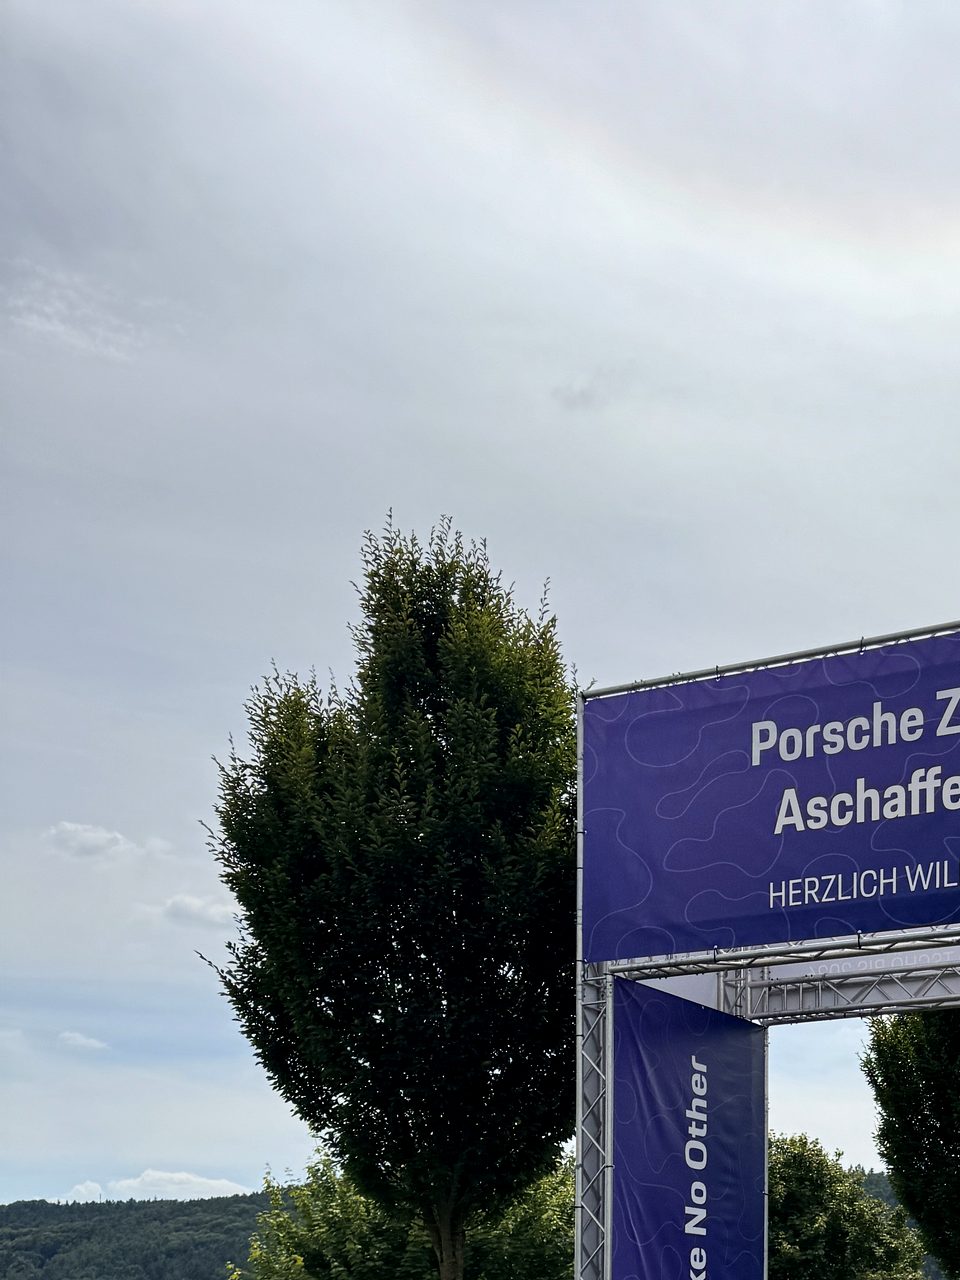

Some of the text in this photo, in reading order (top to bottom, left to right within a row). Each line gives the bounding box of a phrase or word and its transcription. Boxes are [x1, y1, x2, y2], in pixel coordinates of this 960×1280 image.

[751, 702, 924, 766] Porsche
[769, 866, 897, 909] HERZLICH
[684, 1055, 708, 1170] Other
[684, 1181, 707, 1236] No
